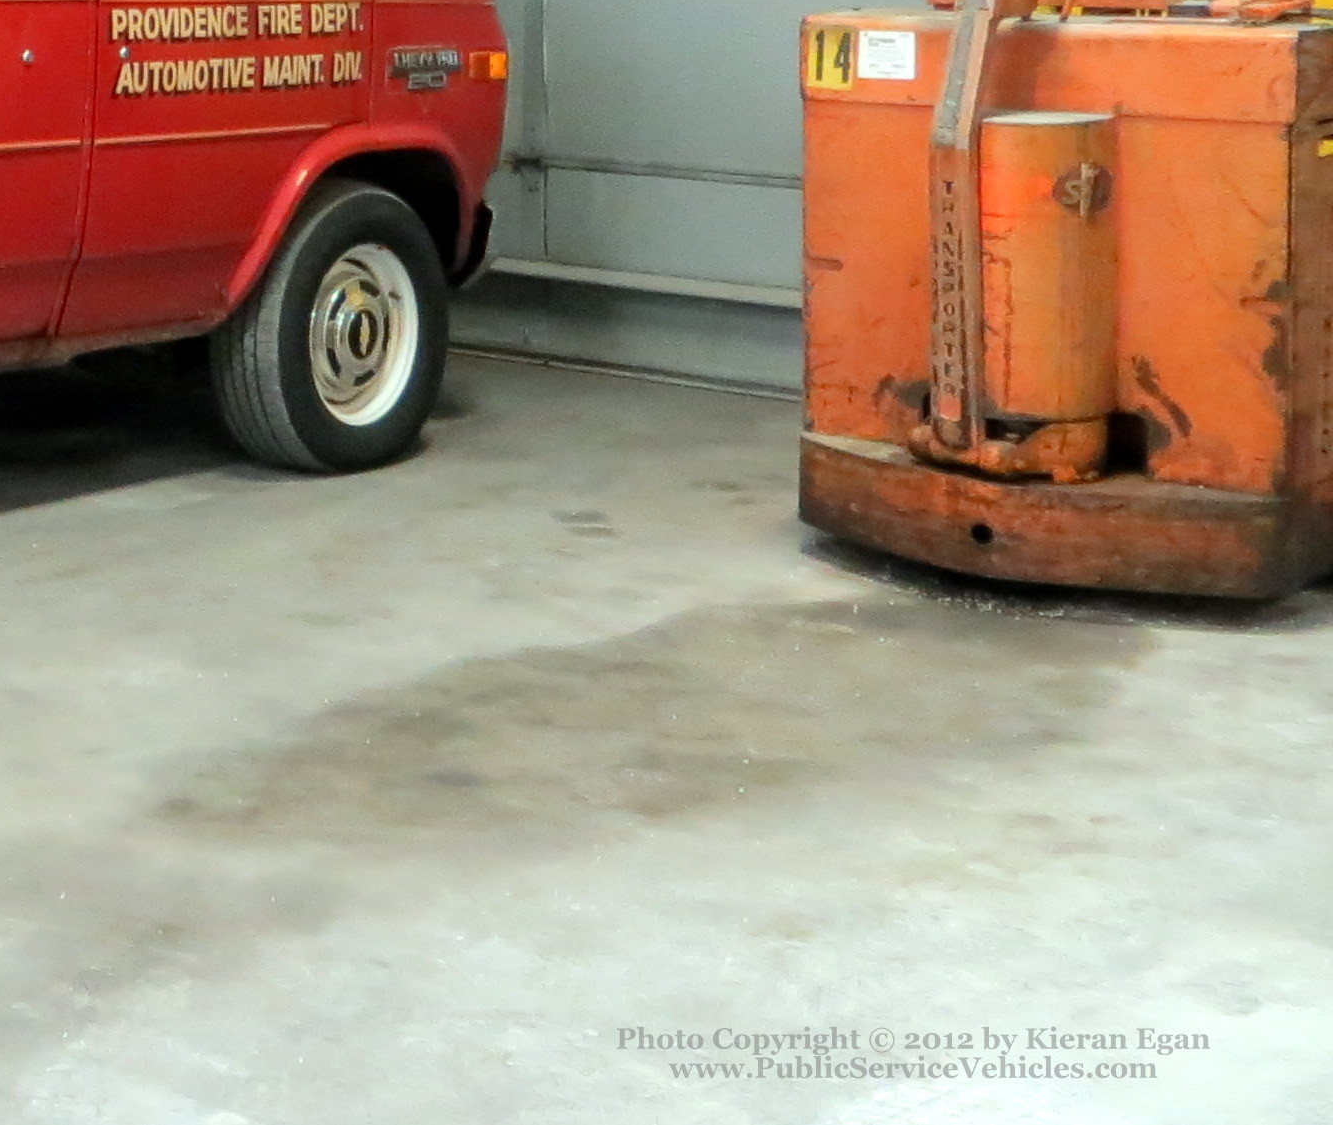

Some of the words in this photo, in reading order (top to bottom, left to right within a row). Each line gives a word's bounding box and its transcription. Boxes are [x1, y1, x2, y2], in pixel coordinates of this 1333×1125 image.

[111, 4, 249, 40] PROVIDENCE
[258, 3, 302, 35] FIRE
[310, 1, 364, 33] DEPT.
[116, 56, 255, 94] AUTOMOTIVE
[263, 54, 324, 87] MAINT.
[333, 52, 362, 84] DIV.
[814, 30, 851, 83] 14
[941, 179, 956, 396] TRANSPORTER
